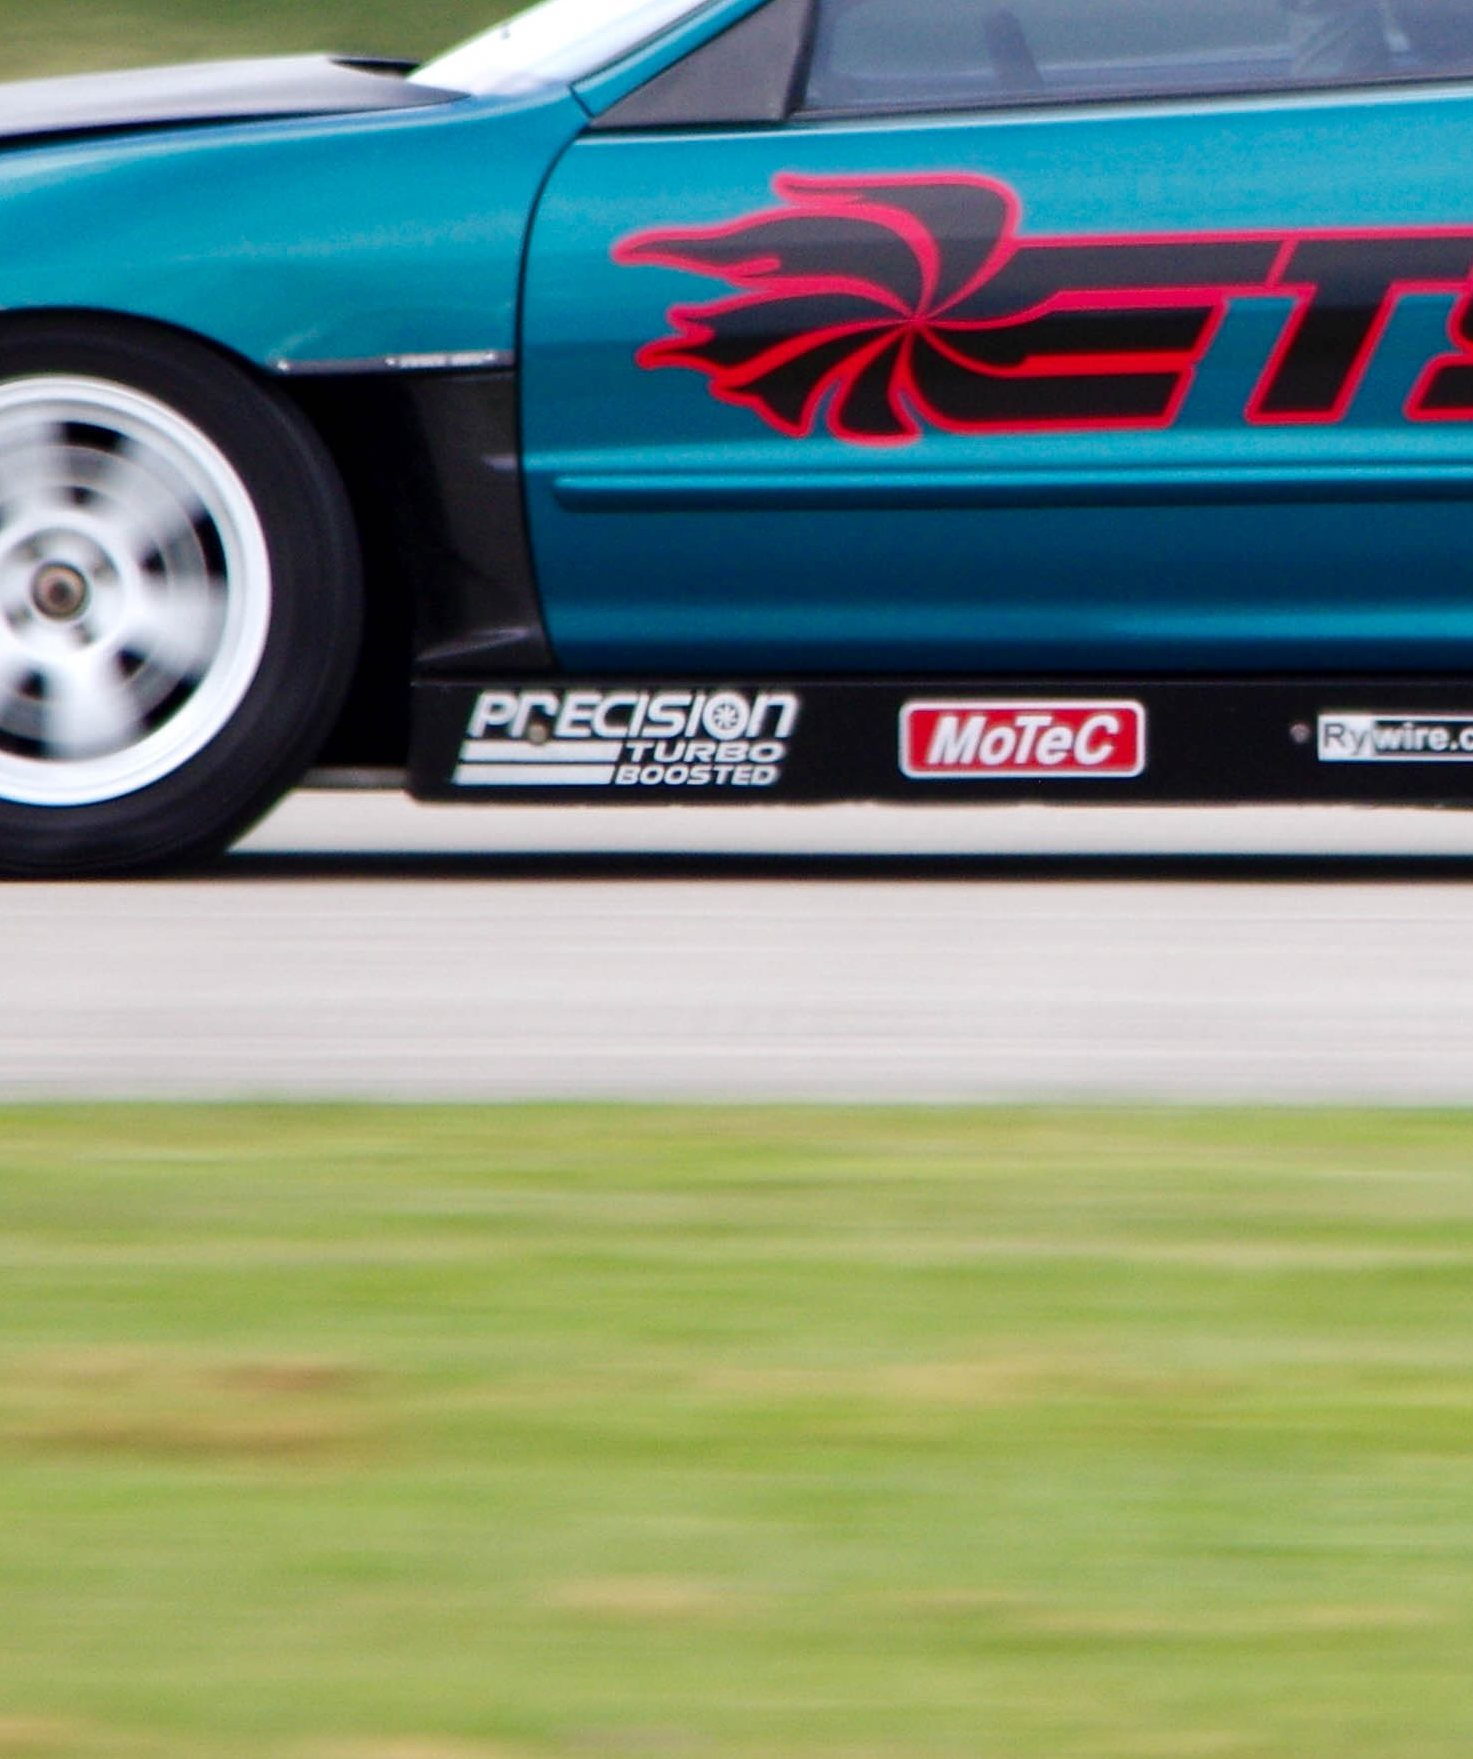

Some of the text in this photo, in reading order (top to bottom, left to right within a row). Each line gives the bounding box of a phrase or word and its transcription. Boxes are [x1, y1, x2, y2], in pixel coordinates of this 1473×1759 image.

[926, 713, 1120, 766] MoTeC
[624, 741, 787, 764] TURBO
[614, 764, 778, 786] BOOSTED
